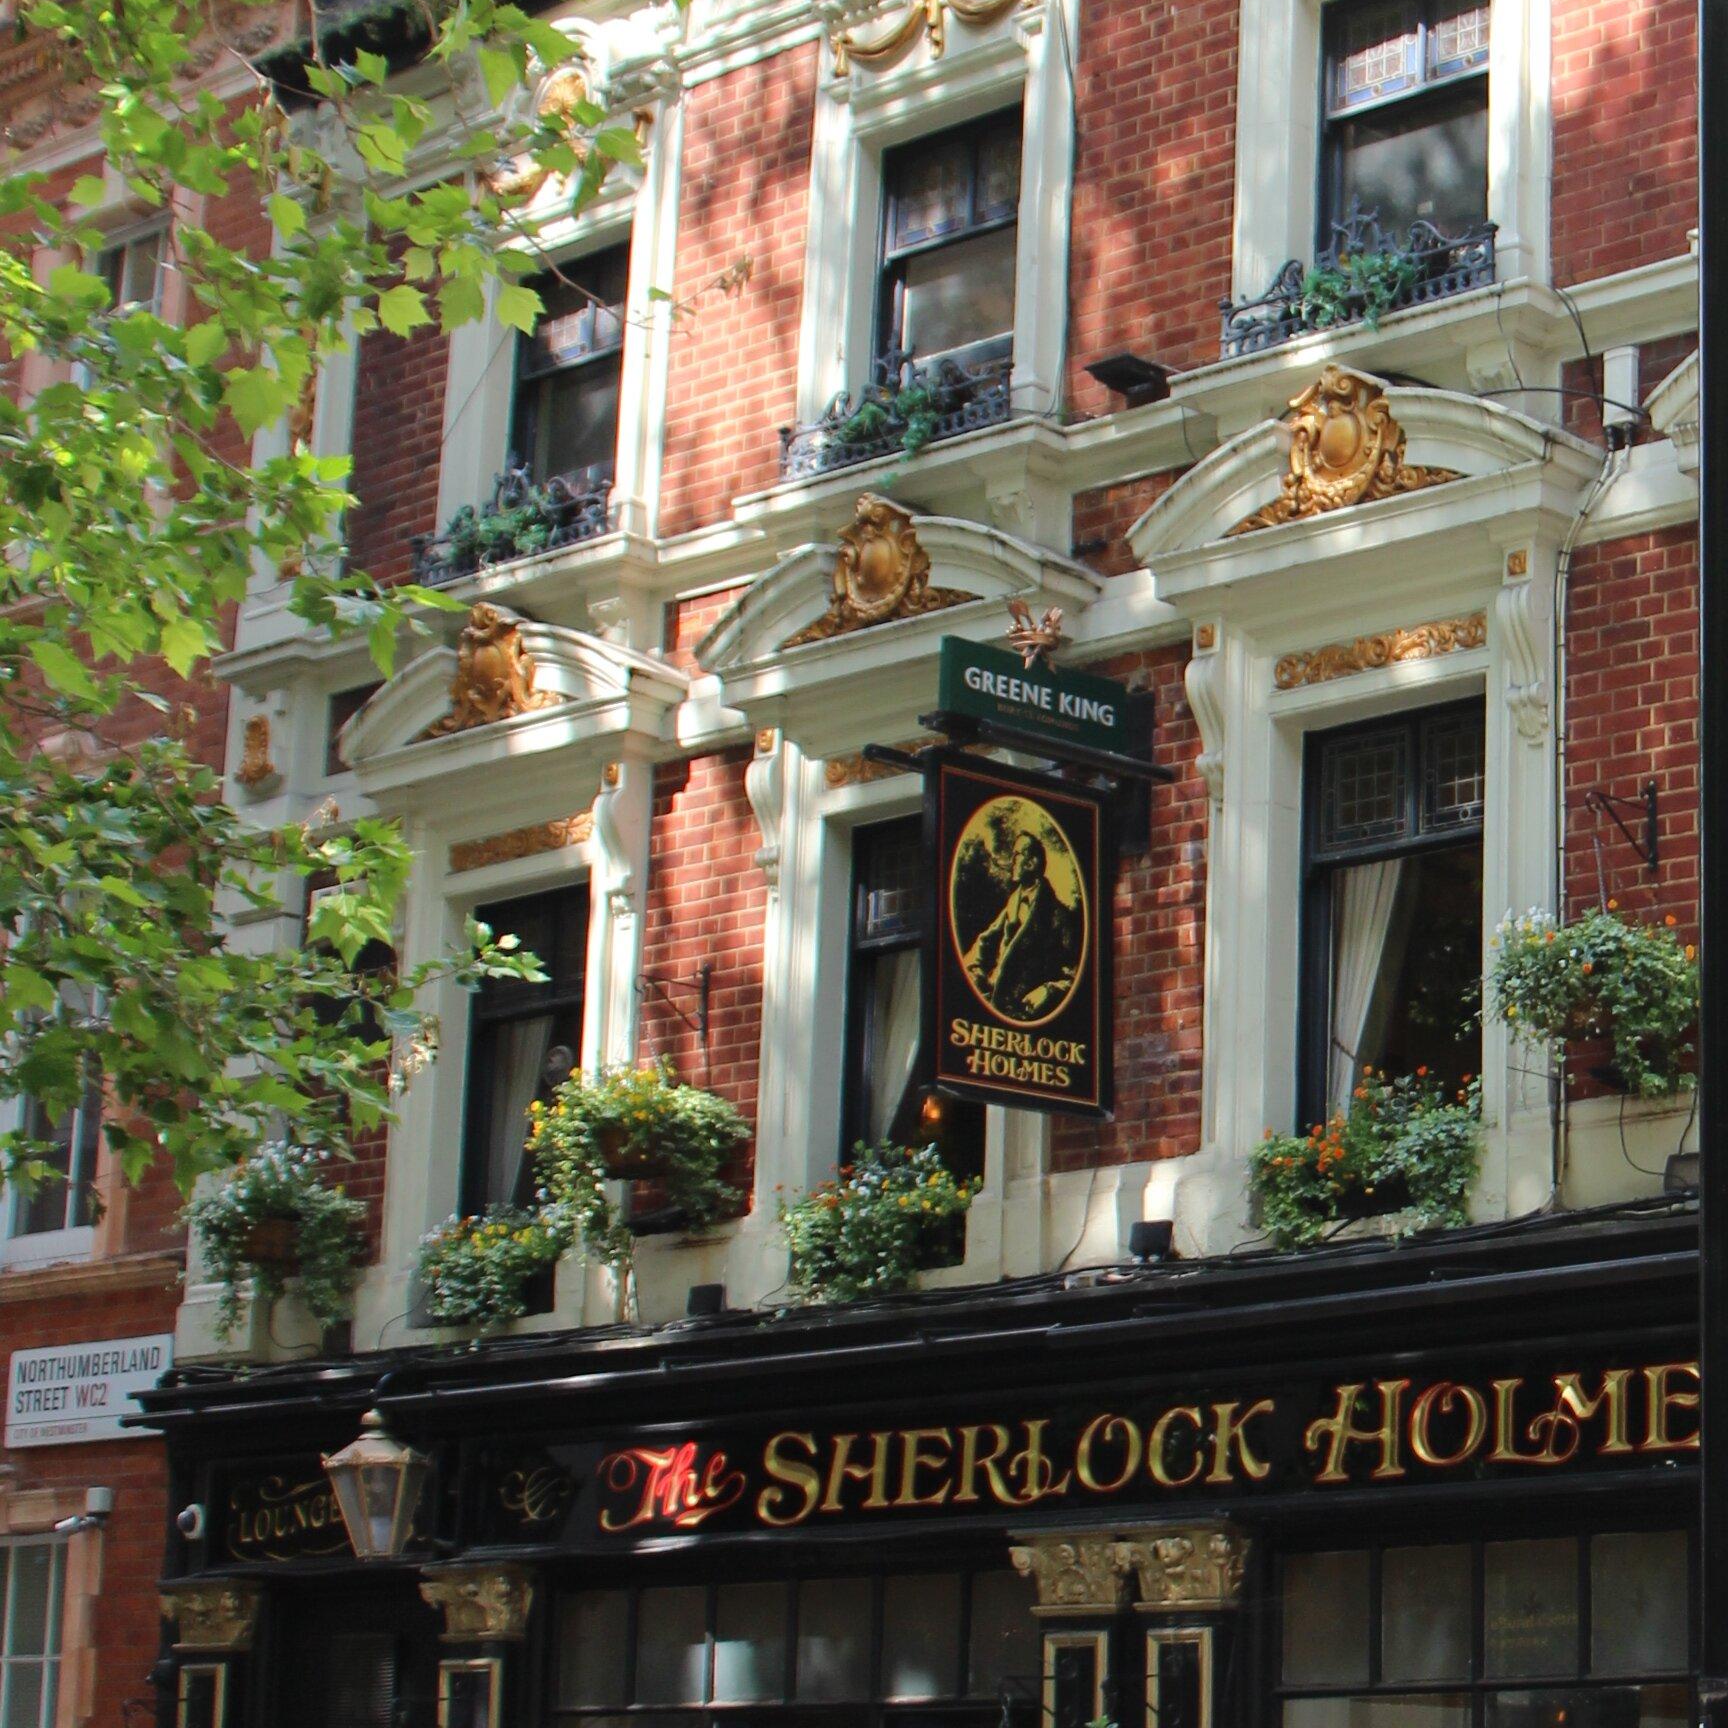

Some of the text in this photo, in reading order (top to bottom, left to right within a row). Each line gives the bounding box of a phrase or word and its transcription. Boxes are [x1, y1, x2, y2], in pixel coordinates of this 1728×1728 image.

[964, 666, 1052, 710] GREENE
[1058, 691, 1115, 727] KING
[950, 1018, 1087, 1065] SHERLOCK
[966, 1048, 1072, 1088] HOLMES
[17, 1347, 160, 1384] NORTHUMBERLAND
[15, 1382, 108, 1414] STREET WC2
[597, 1440, 747, 1533] The
[755, 1398, 1276, 1528] SHERLOCK
